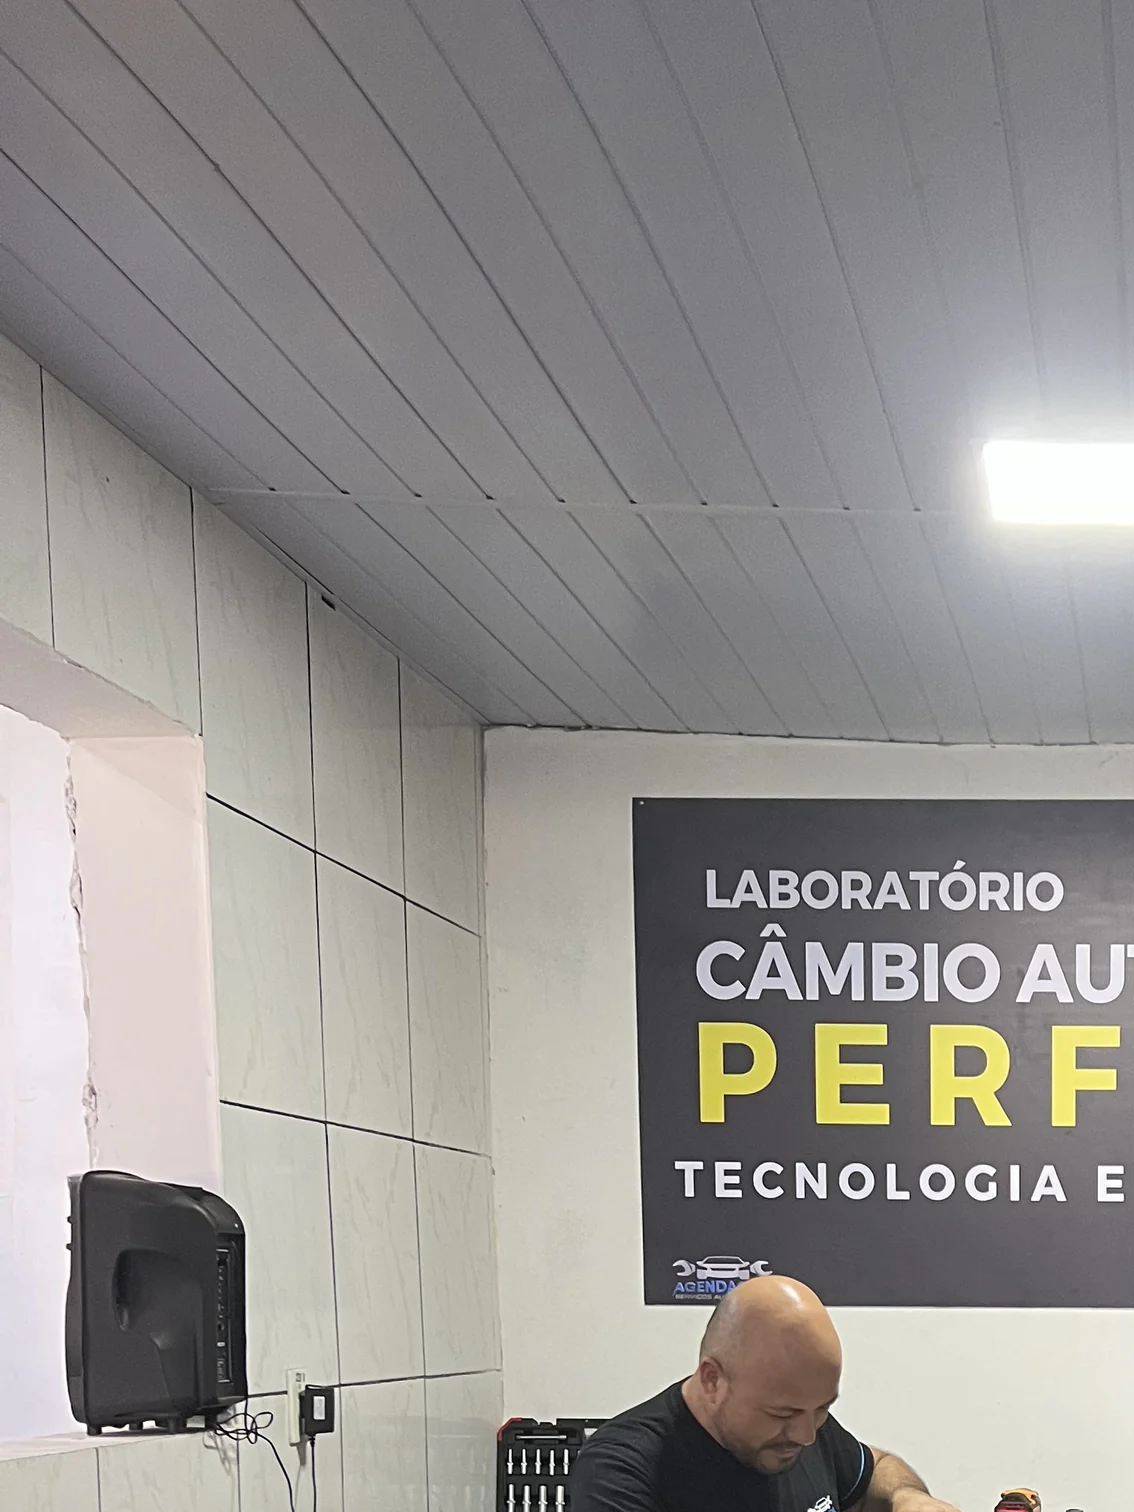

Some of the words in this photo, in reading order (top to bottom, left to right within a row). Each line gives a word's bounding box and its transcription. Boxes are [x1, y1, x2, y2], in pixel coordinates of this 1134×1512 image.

[705, 859, 1065, 912] LABORATÓRIO
[695, 923, 1001, 1003] CÂMBIO
[674, 1160, 1067, 1203] TECNOLOGIA
[673, 1280, 738, 1295] AGENDA
